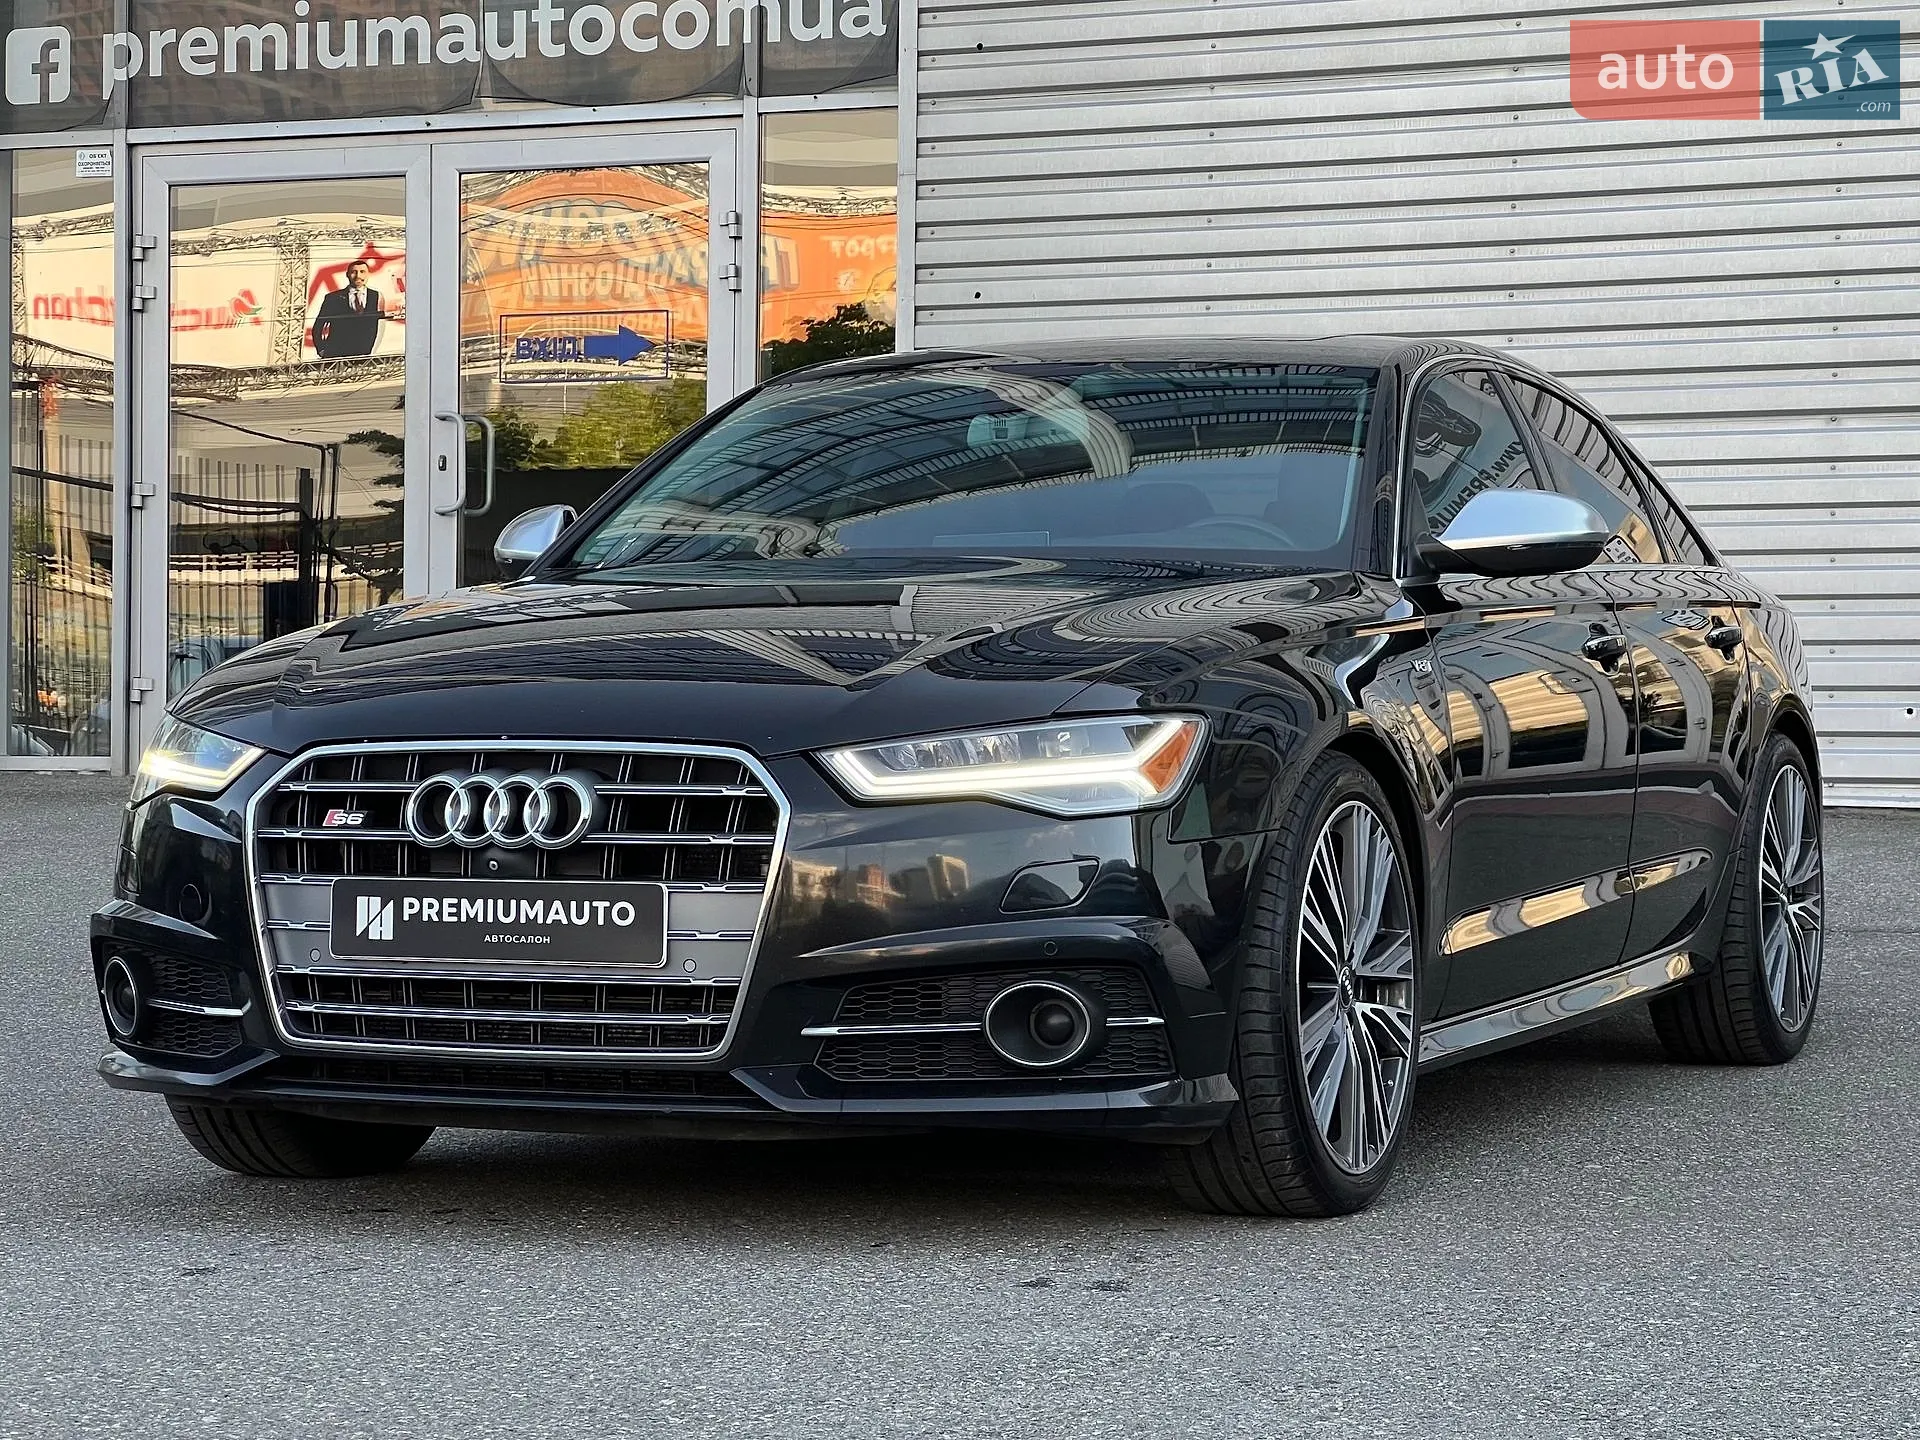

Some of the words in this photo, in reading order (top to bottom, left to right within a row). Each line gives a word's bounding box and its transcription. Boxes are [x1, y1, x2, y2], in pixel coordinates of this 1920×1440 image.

[516, 336, 578, 360] ВХІД
[331, 813, 364, 825] S6
[402, 897, 636, 927] PREMIUMAUTO
[483, 934, 551, 944] АВТОСАЛОН
